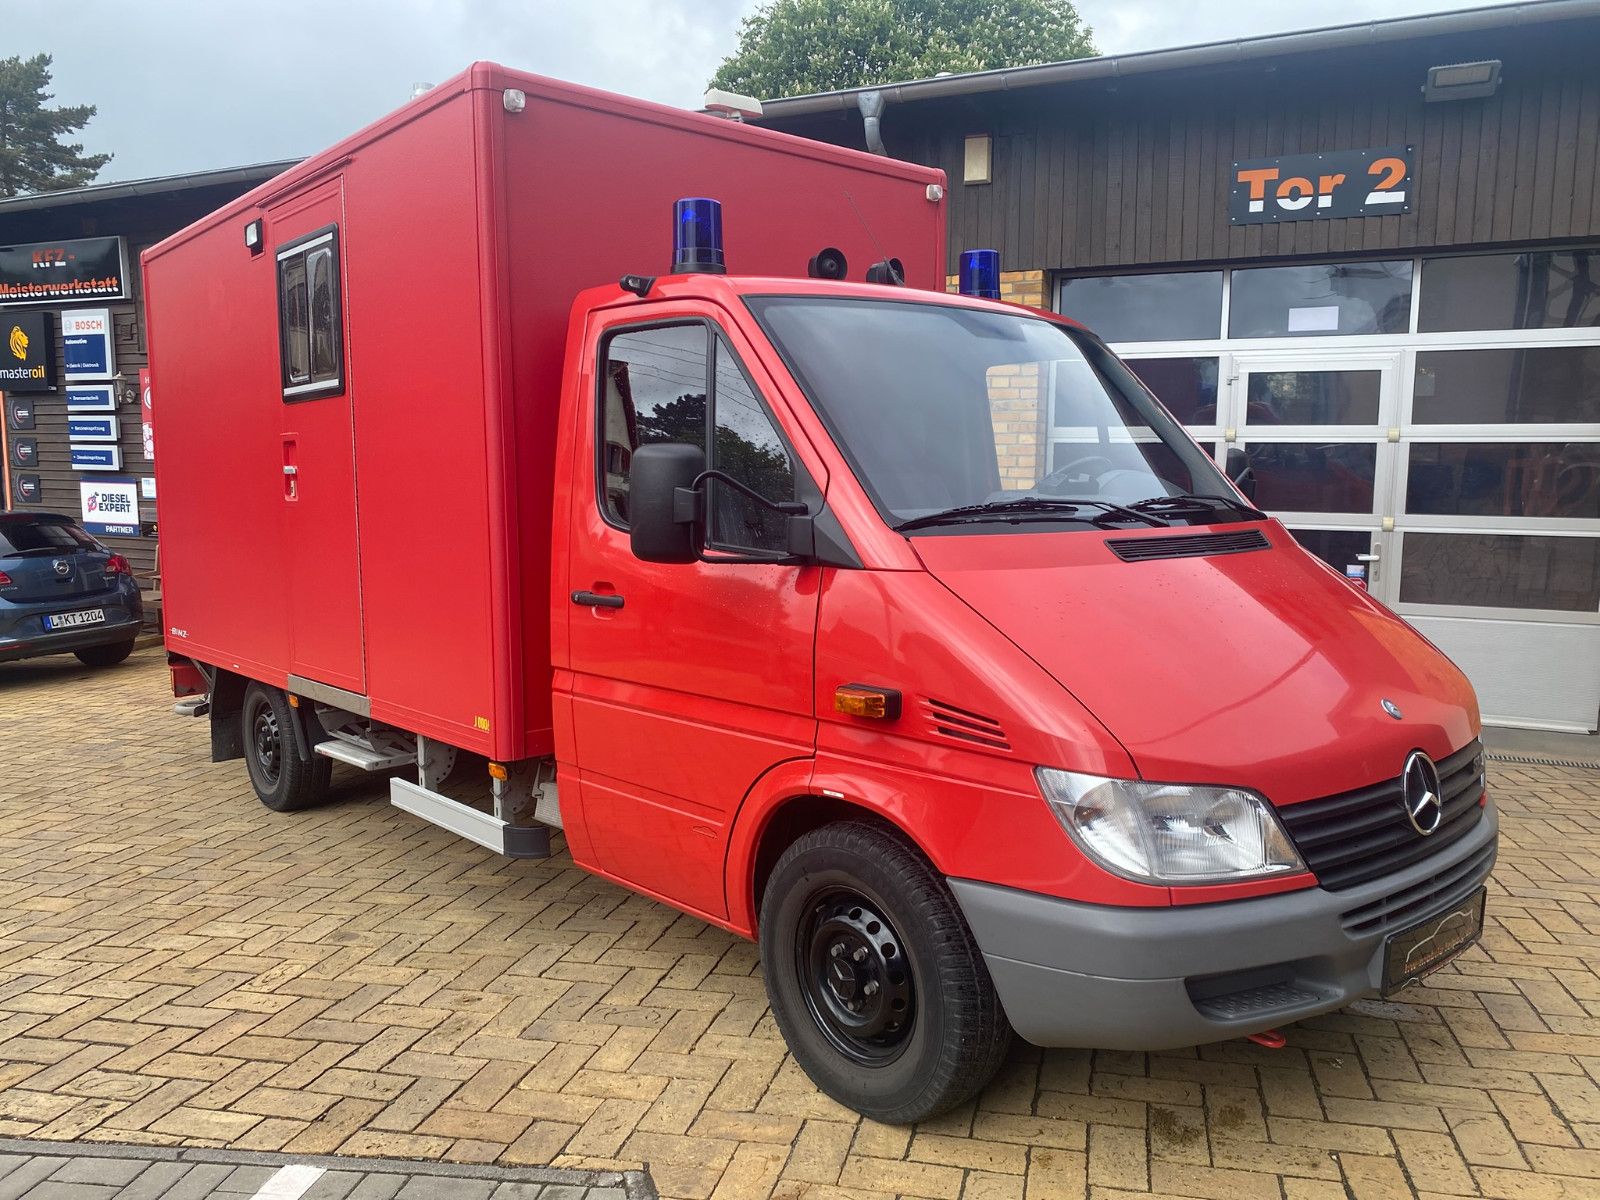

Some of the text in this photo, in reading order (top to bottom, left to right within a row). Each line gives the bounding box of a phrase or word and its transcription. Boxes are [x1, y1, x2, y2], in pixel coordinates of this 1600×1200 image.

[1237, 157, 1407, 212] Tor 2
[0, 276, 119, 299] Meisterwerkstatt
[75, 320, 103, 330] BOSCH
[0, 365, 45, 379] masteroil
[101, 493, 131, 503] DIESEL
[98, 502, 131, 513] EXPERT
[105, 525, 134, 534] PARTNER
